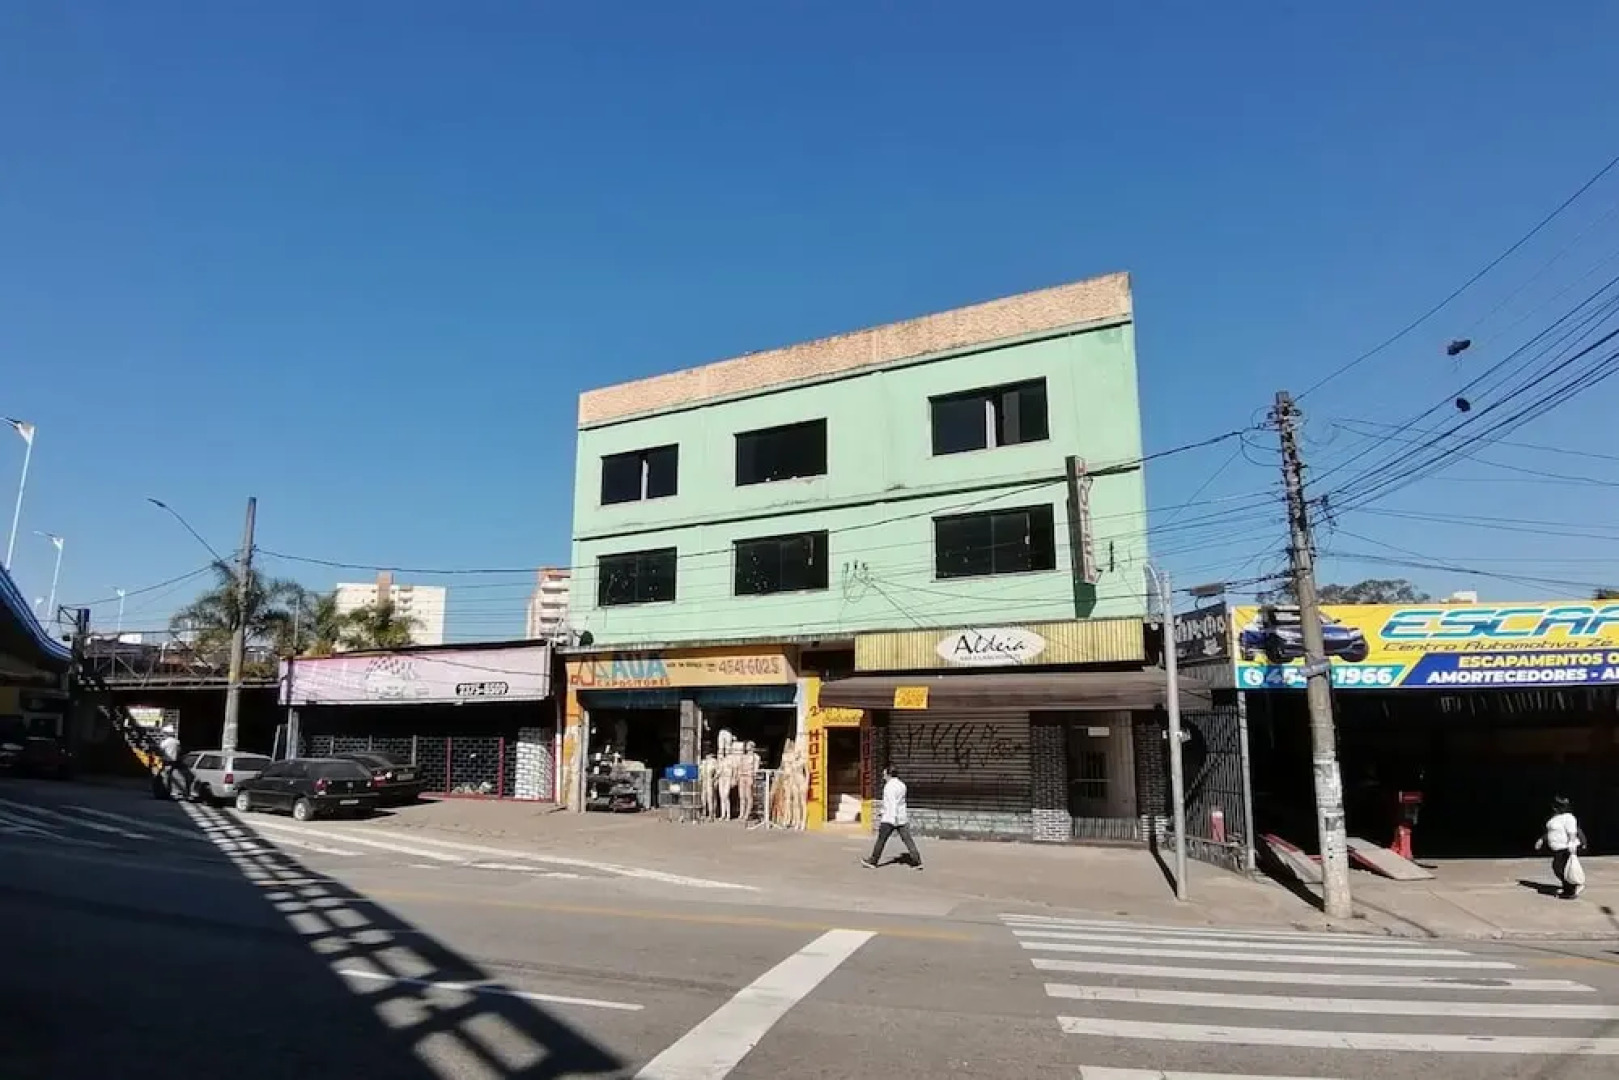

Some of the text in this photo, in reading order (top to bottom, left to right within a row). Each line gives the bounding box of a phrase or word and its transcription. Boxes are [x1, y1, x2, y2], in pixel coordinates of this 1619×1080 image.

[953, 634, 1025, 655] Aldeia
[1383, 641, 1457, 651] Centro
[1463, 639, 1579, 651] Automotivo
[1459, 653, 1603, 668] ESCAPAMENTOS
[1427, 668, 1587, 684] AMORTECEDORES
[807, 729, 820, 802] HOTEL
